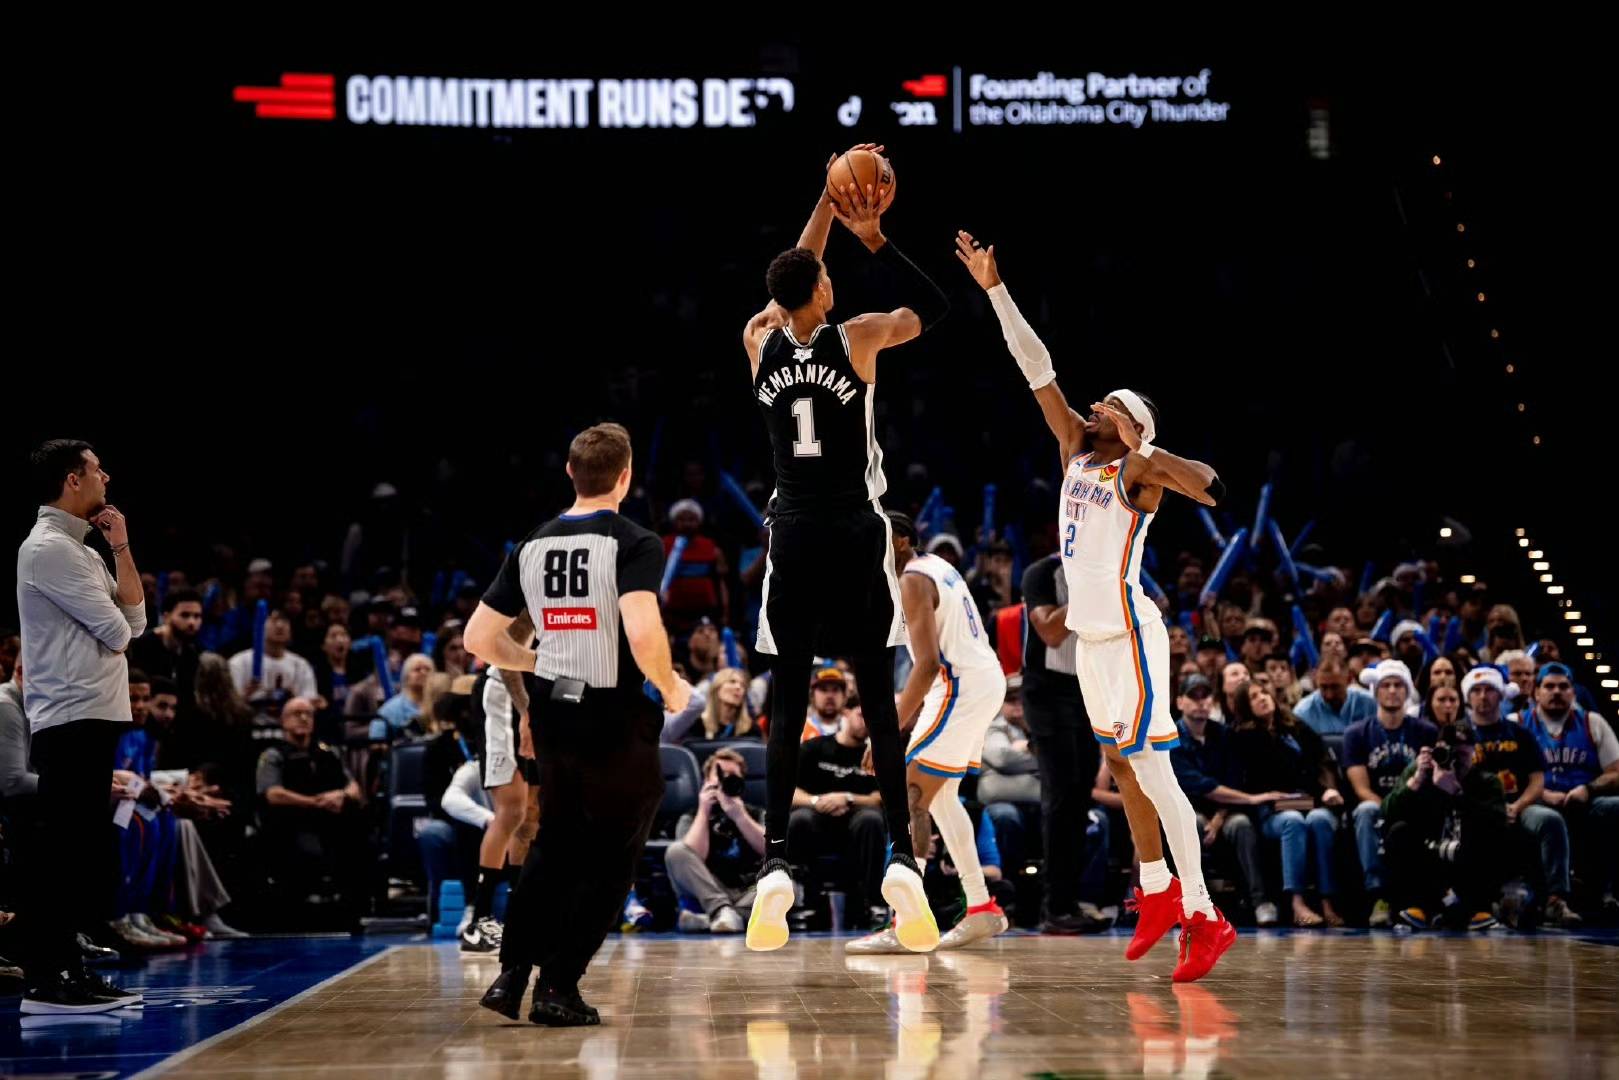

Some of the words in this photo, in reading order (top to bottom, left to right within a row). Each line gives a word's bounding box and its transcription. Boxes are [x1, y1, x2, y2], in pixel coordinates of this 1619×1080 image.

[346, 75, 594, 127] COMMITMENT
[599, 79, 699, 127] RUNS
[970, 71, 1085, 105] Founding
[1087, 72, 1181, 98] Partner
[1182, 68, 1211, 97] of
[969, 101, 1003, 125] the
[1005, 101, 1104, 124] Oklahoma
[1105, 100, 1148, 128] City
[1149, 99, 1229, 122] Thunder
[758, 364, 857, 407] WEMBANYAMA
[791, 397, 822, 457] 1
[1064, 523, 1076, 558] 2
[544, 548, 590, 598] 86
[547, 612, 592, 625] Emirates
